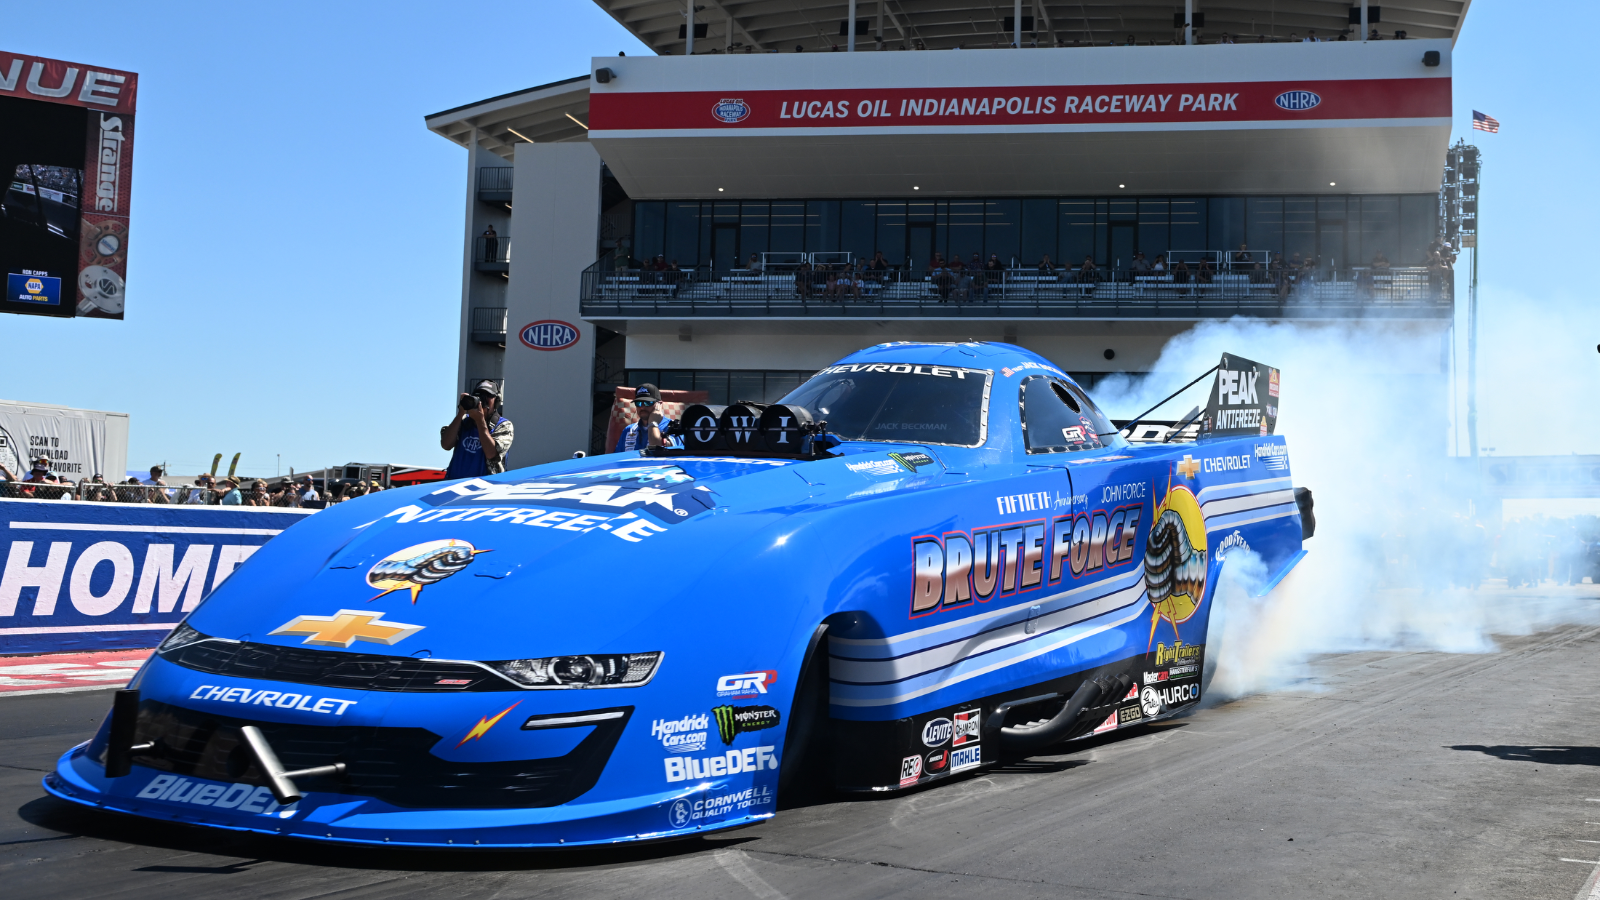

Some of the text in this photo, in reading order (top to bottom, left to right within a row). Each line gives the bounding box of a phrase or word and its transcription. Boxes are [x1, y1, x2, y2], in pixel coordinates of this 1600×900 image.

[780, 92, 1239, 118] LUCAS OIL INDIANAPOLIS RACEWAY PARK
[1279, 92, 1319, 110] NHRA
[97, 113, 125, 212] Strange
[28, 282, 41, 290] NAPA
[527, 324, 572, 347] NHRA
[812, 363, 970, 379] HEVROLET
[1218, 369, 1259, 405] PEAK
[875, 422, 948, 431] JACK BECKMAN
[1216, 409, 1260, 430] ANTIFREEZE
[30, 435, 60, 448] SCAN TO
[30, 448, 69, 461] DOWNLOAD
[1203, 454, 1251, 473] CHEVROLET
[50, 461, 82, 474] FAVORITE
[431, 478, 681, 512] PEAK
[996, 482, 1146, 515] FIFTIETH Anniversary JOHN FORCE
[911, 505, 1142, 616] BRUTE FORCE
[716, 669, 778, 694] GRP
[189, 685, 358, 716] CHEVROLET
[1157, 683, 1199, 706] HURCO
[651, 713, 709, 740] Hendrick
[735, 709, 777, 721] MONSTER
[662, 731, 707, 747] Cars.com
[955, 720, 978, 736] CHAMPION
[664, 745, 775, 783] BlueDEF
[952, 747, 979, 768] MAHLE
[692, 797, 772, 820] QUALITY TOOLS
[694, 785, 770, 811] CORNWELL
